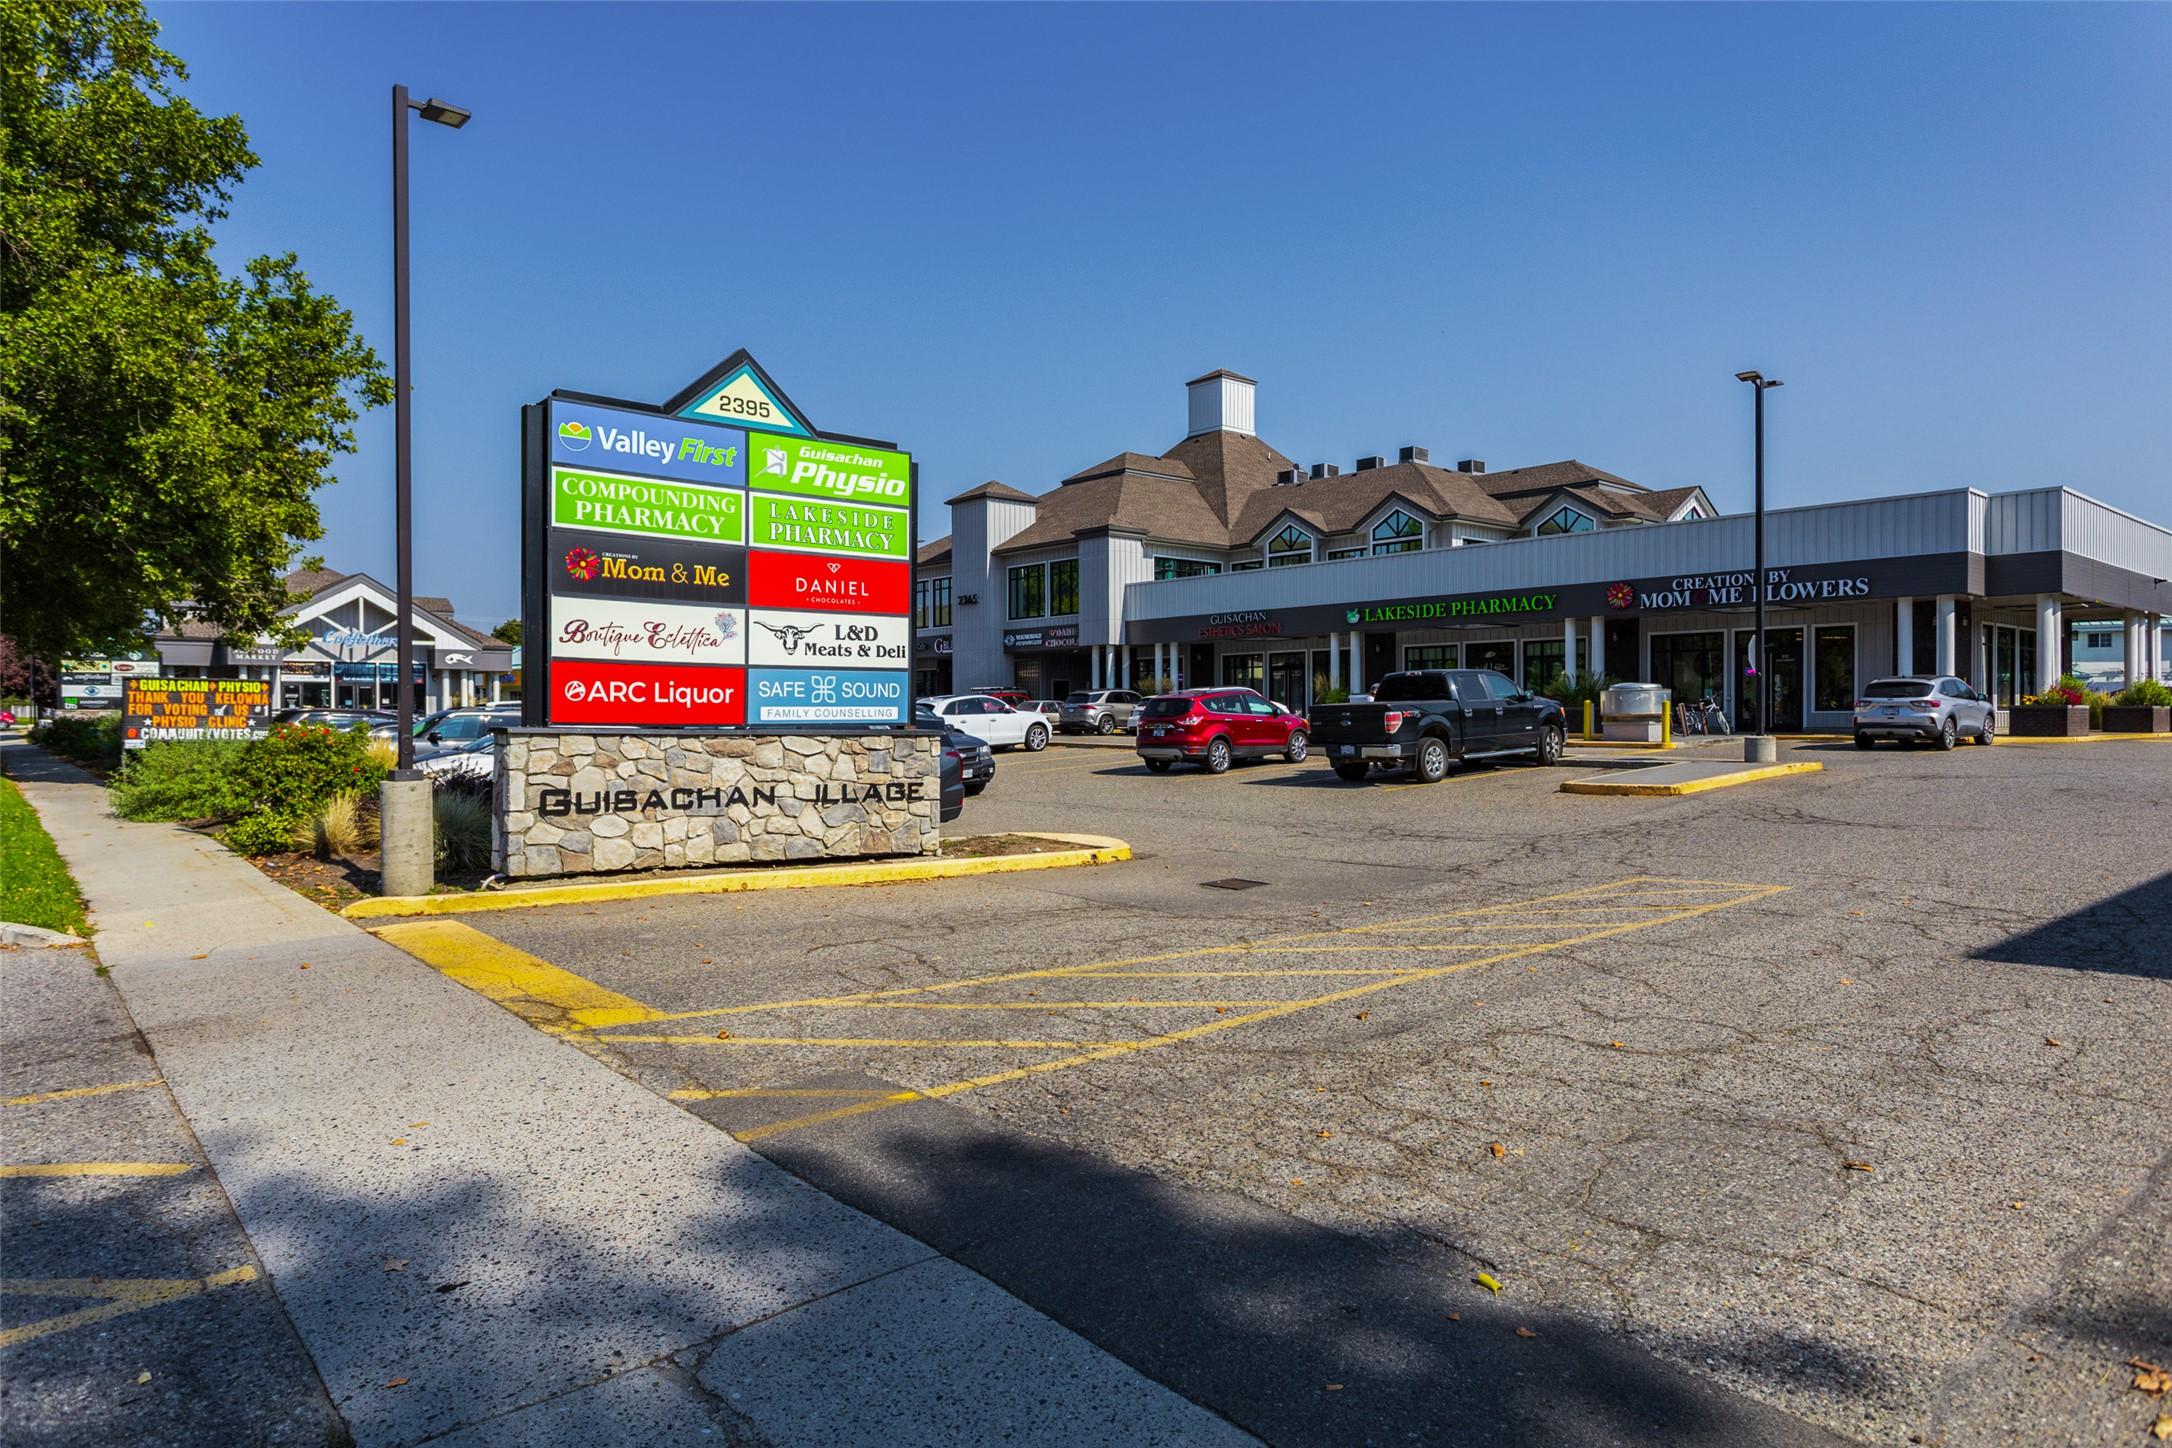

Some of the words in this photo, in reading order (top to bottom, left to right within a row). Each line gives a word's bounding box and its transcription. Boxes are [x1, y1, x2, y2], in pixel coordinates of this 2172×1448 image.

[719, 395, 770, 418] 2395
[596, 426, 675, 465] Valley
[677, 437, 737, 467] First
[799, 445, 884, 468] Guisachan
[790, 461, 906, 497] Physio
[562, 477, 736, 514] COMPOUNDING
[575, 500, 726, 535] PHARMACY
[769, 502, 894, 531] LAKESIDE
[769, 522, 894, 551] PHARMACY
[601, 557, 666, 583] Mom
[671, 562, 689, 585] &
[693, 564, 730, 587] Me
[1768, 569, 1792, 585] BY
[795, 577, 870, 597] DANIEL
[1640, 590, 1692, 609] MOM
[1707, 586, 1743, 605] ME
[811, 596, 856, 605] CHOCOLATES
[1364, 602, 1447, 622] LAKESIDE
[1451, 594, 1557, 617] PHARMACY
[1210, 611, 1267, 625] GUISACHAN
[558, 619, 644, 657] Boutique
[835, 624, 879, 642] L&D
[804, 642, 852, 657] Meats
[857, 644, 871, 658] &
[876, 645, 906, 659] Deli
[139, 679, 209, 692] GUISACHAN
[218, 681, 261, 693] PHYSIO
[586, 681, 647, 703] ARC
[654, 680, 734, 709] Liquor
[758, 681, 806, 698] SAFE
[841, 682, 900, 699] SOUND
[128, 691, 169, 704] THANK
[180, 692, 205, 704] YOU
[215, 692, 270, 705] KELOWNA
[128, 703, 153, 716] FOR
[164, 704, 208, 716] VOTING
[233, 704, 249, 716] US
[152, 715, 197, 728] PHYSIO
[207, 716, 247, 728] CLINIC
[767, 708, 810, 718] FAMILY
[814, 708, 893, 718] COUNSELLING
[539, 785, 776, 818] GUISACHAN
